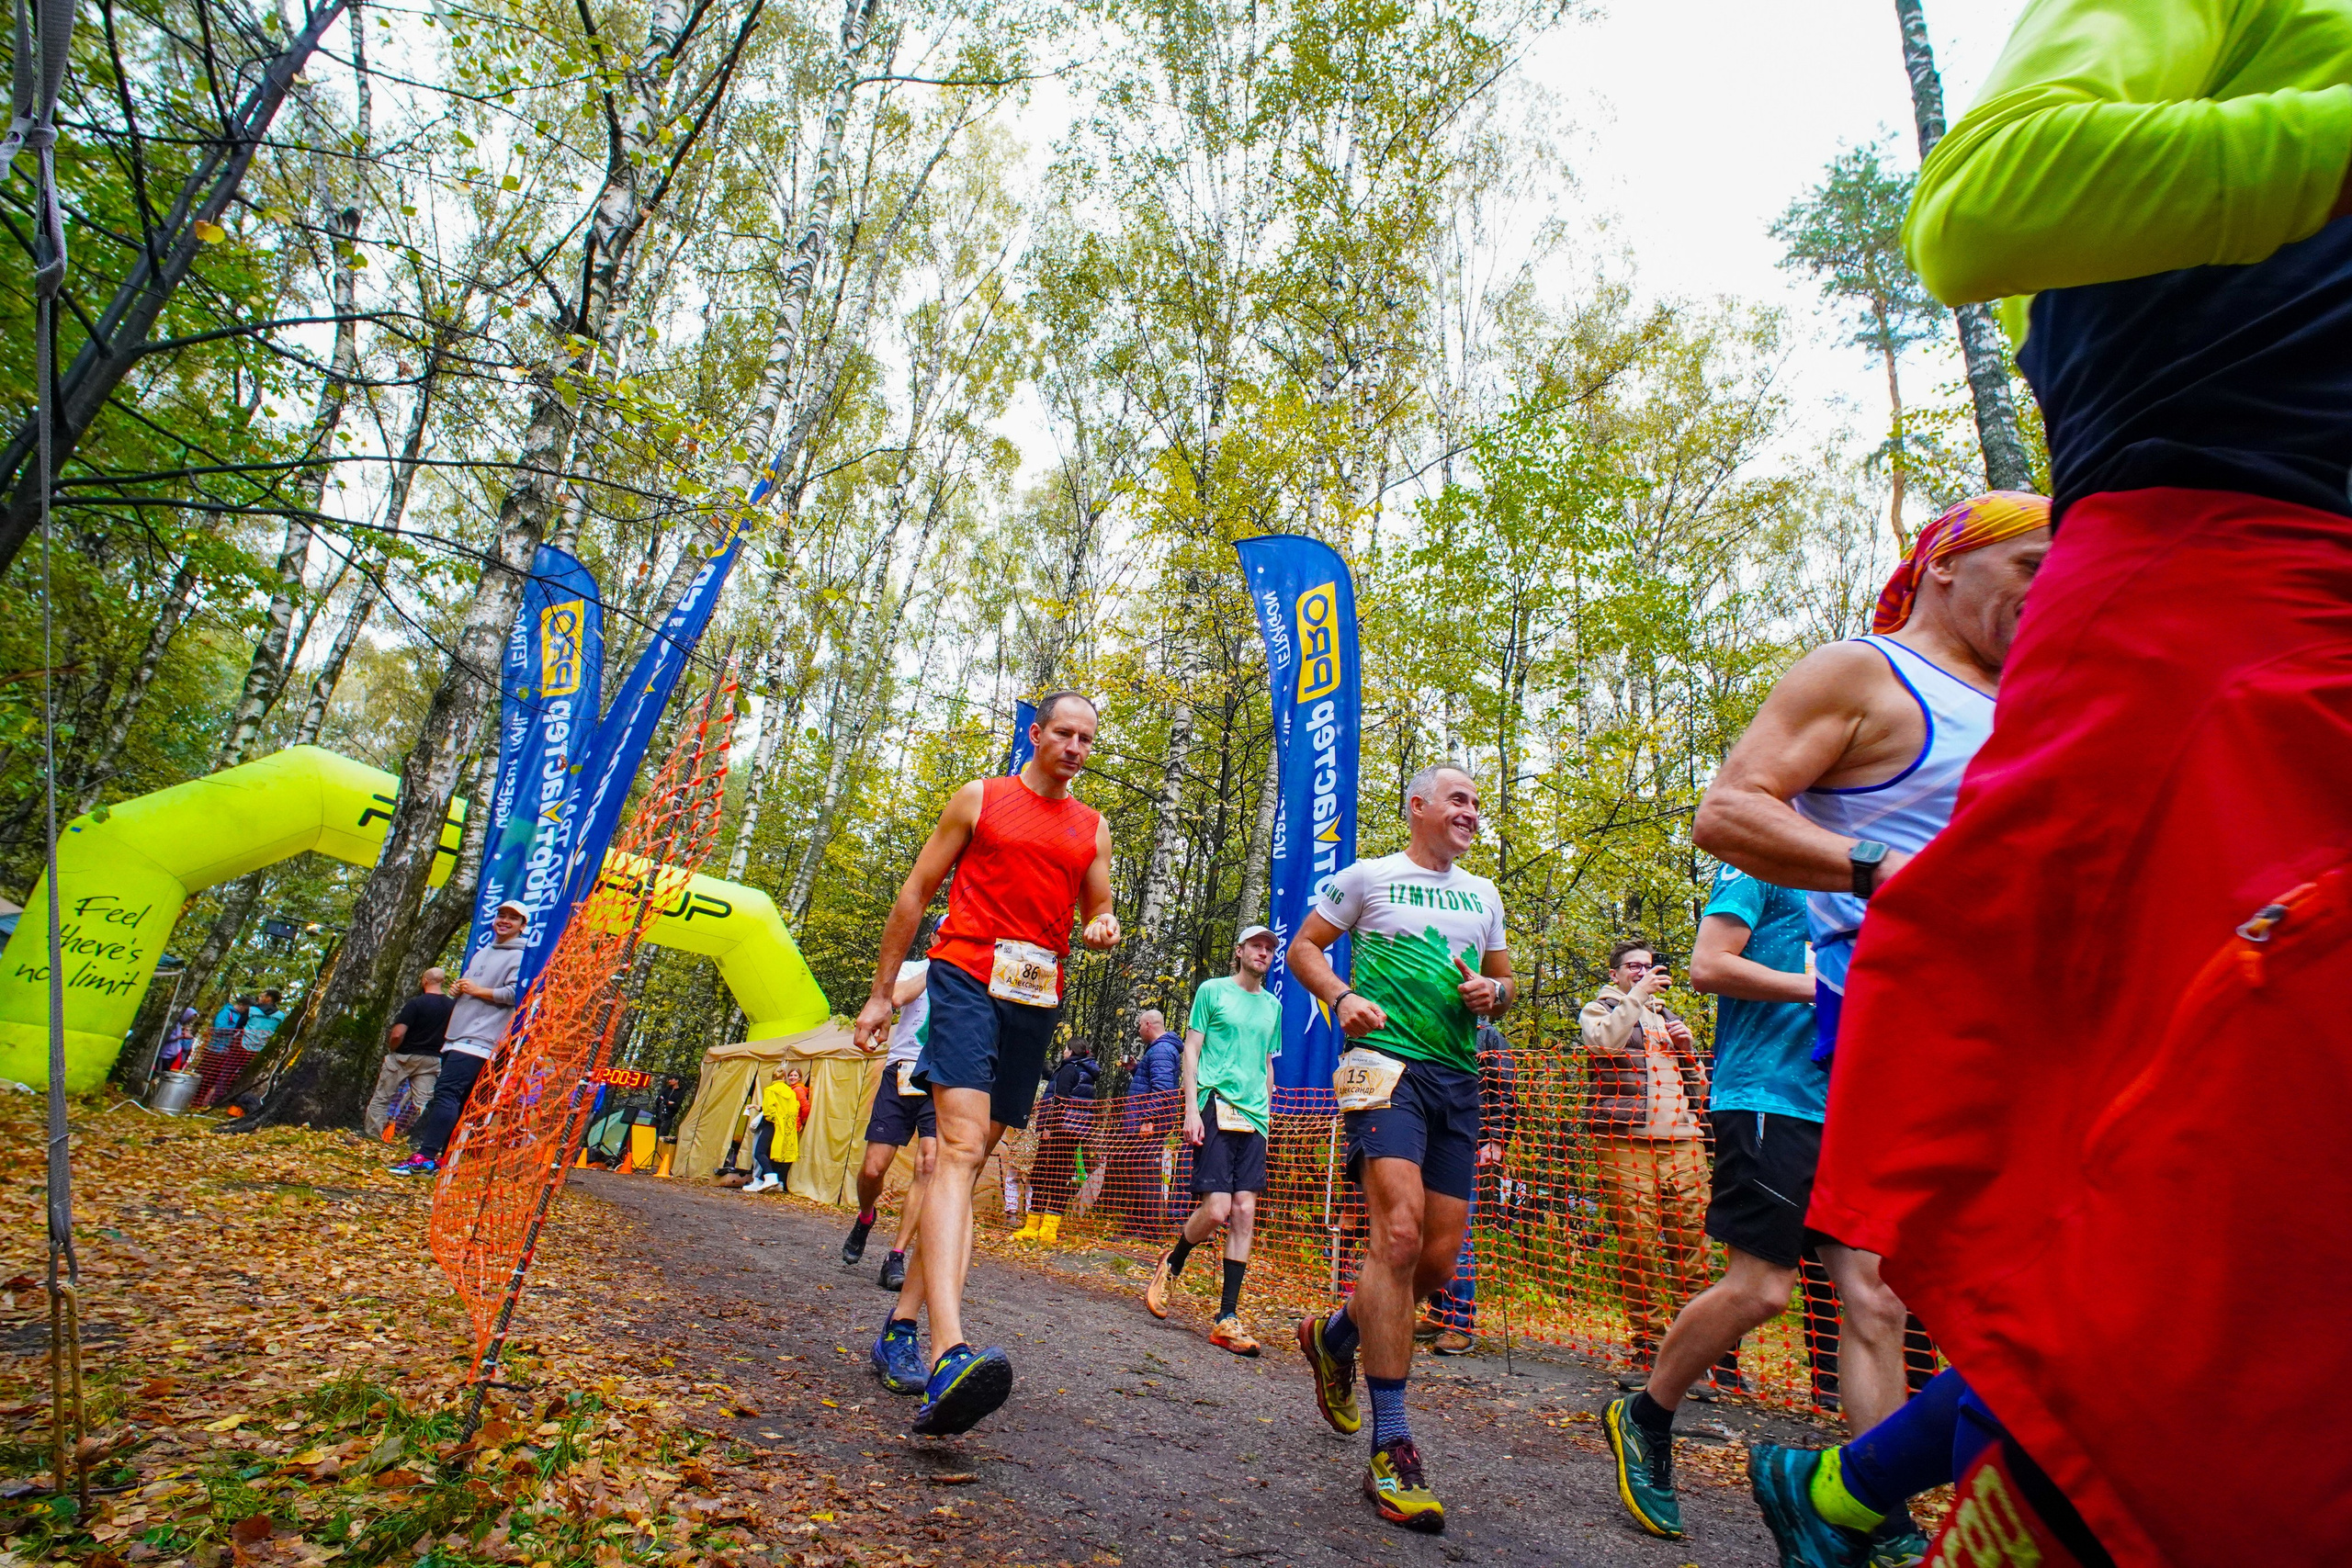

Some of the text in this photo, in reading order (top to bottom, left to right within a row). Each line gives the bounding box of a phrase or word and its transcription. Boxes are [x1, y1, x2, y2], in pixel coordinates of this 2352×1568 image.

[74, 896, 153, 929] Feel
[1389, 883, 1484, 915] IZMYLONG
[15, 961, 141, 997] no limit
[1022, 964, 1040, 981] 86
[1347, 1069, 1368, 1084] 15
